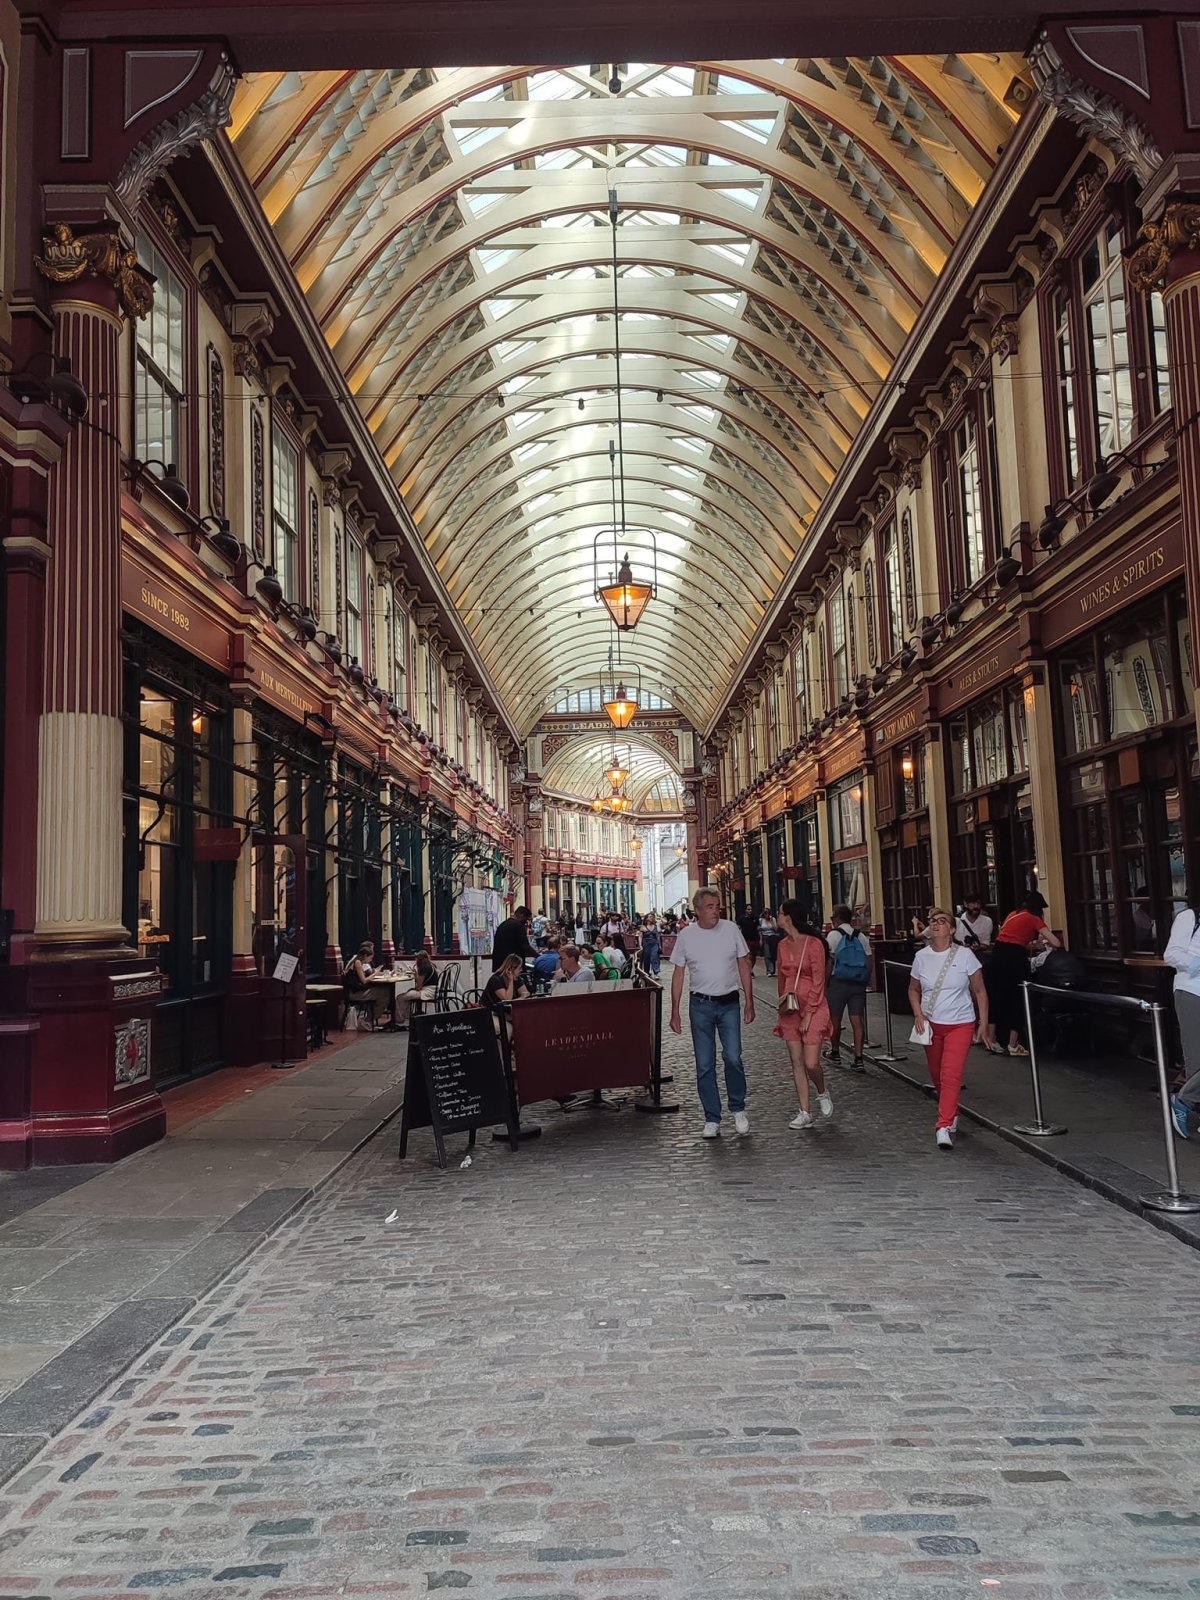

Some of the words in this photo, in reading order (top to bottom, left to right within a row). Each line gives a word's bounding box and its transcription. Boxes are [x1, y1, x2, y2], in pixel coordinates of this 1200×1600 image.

[1080, 582, 1110, 613] WINES
[1112, 576, 1120, 594] &
[1122, 547, 1164, 588] SPIRITS
[141, 587, 169, 617] SINCE
[171, 608, 190, 631] 1982
[260, 669, 274, 690] AUX
[959, 673, 972, 692] ALES
[977, 655, 999, 680] STOUTS
[571, 721, 649, 730] LEADEALL
[884, 721, 897, 741] NEW
[896, 709, 916, 734] MOON
[544, 1032, 615, 1048] LEADENHALL
